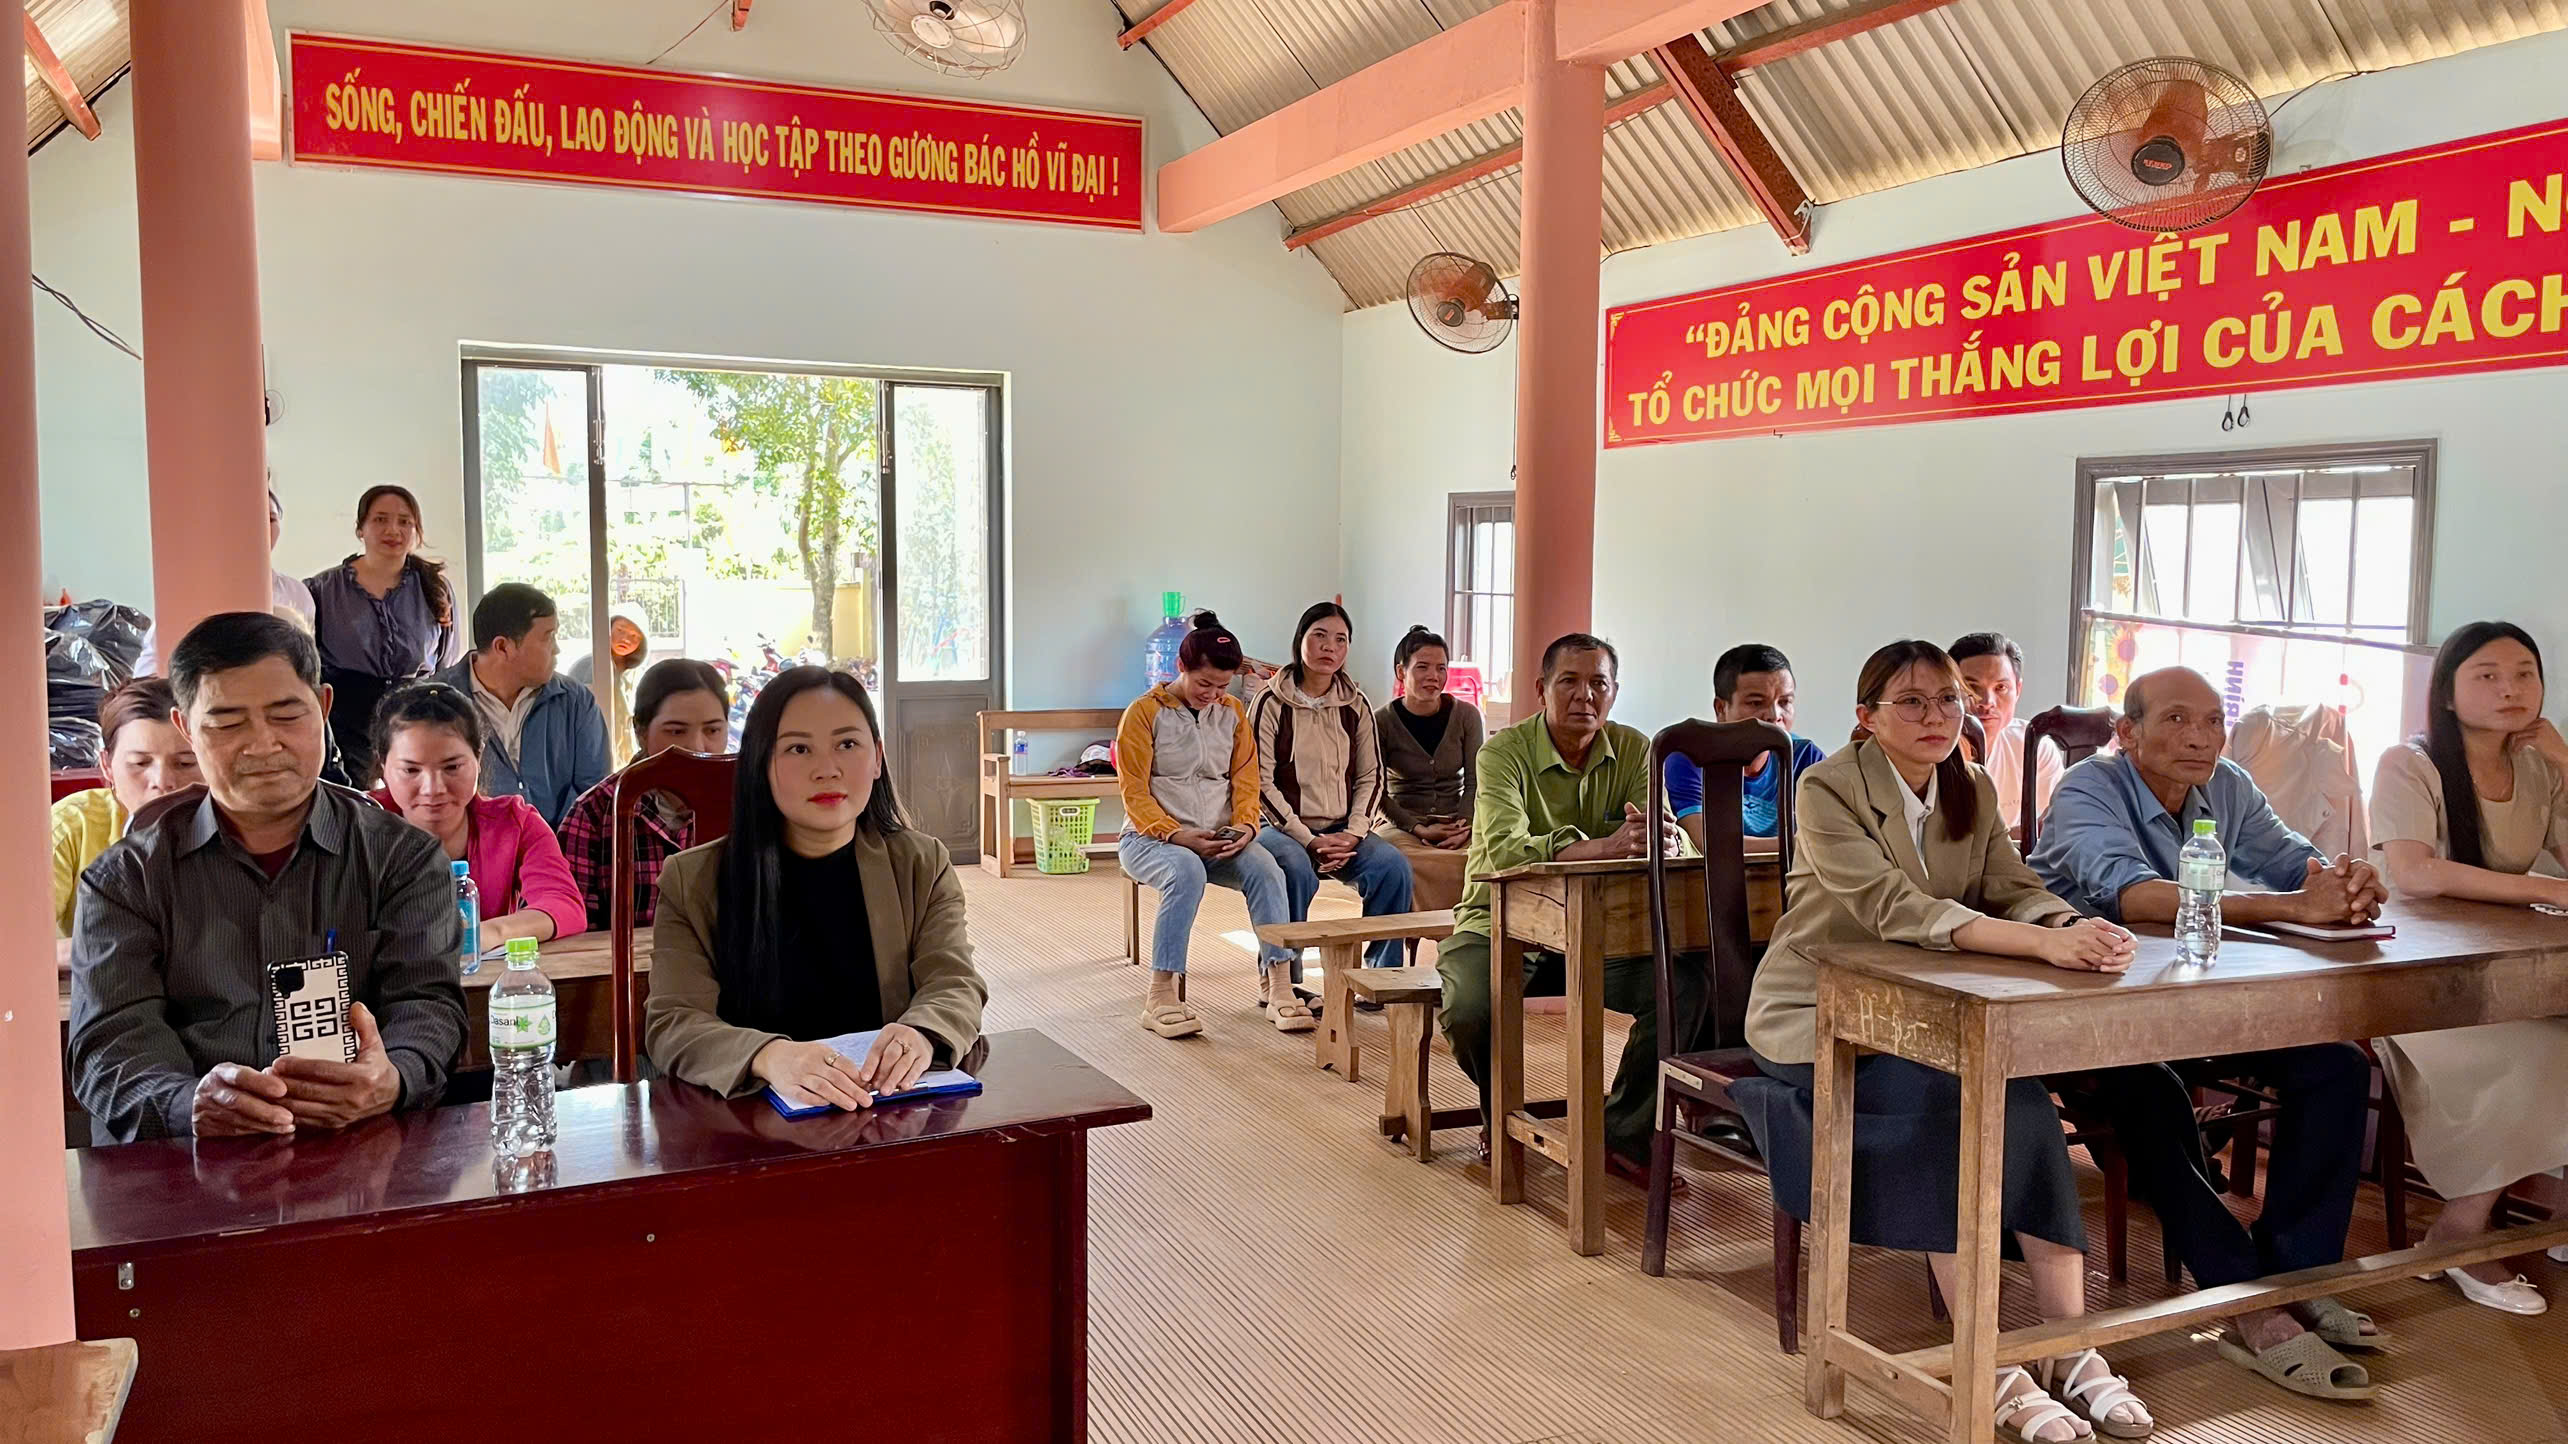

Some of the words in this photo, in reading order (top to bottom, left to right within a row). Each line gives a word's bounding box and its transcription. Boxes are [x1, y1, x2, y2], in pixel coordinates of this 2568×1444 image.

[325, 67, 402, 144] SỐNG,
[410, 78, 487, 142] CHIẾN
[494, 83, 553, 157] ĐẤU,
[560, 105, 607, 153] LAO
[613, 100, 679, 165] ĐỘNG
[684, 106, 715, 162] VÀ
[722, 119, 769, 174] HỌC
[775, 115, 819, 178] TẬP
[824, 130, 883, 176] THEO
[888, 130, 958, 183] GƯƠNG
[964, 133, 1006, 187] BÁC
[1012, 131, 1040, 190] HỒ
[1046, 142, 1067, 192] VĨ
[1071, 153, 1105, 203] ĐẠI
[1822, 283, 1945, 345] CỘNG
[1960, 251, 2068, 320] SẢN
[2087, 231, 2230, 303] VIỆT
[2255, 199, 2418, 277] NAM
[2507, 173, 2568, 238] N
[1628, 369, 1673, 428] TỔ
[1682, 368, 1783, 423] CHỨC
[1795, 362, 1876, 415] MỌI
[1890, 329, 2062, 401] THẮNG
[2081, 319, 2180, 387] LỢI
[2203, 290, 2344, 369] CỦA
